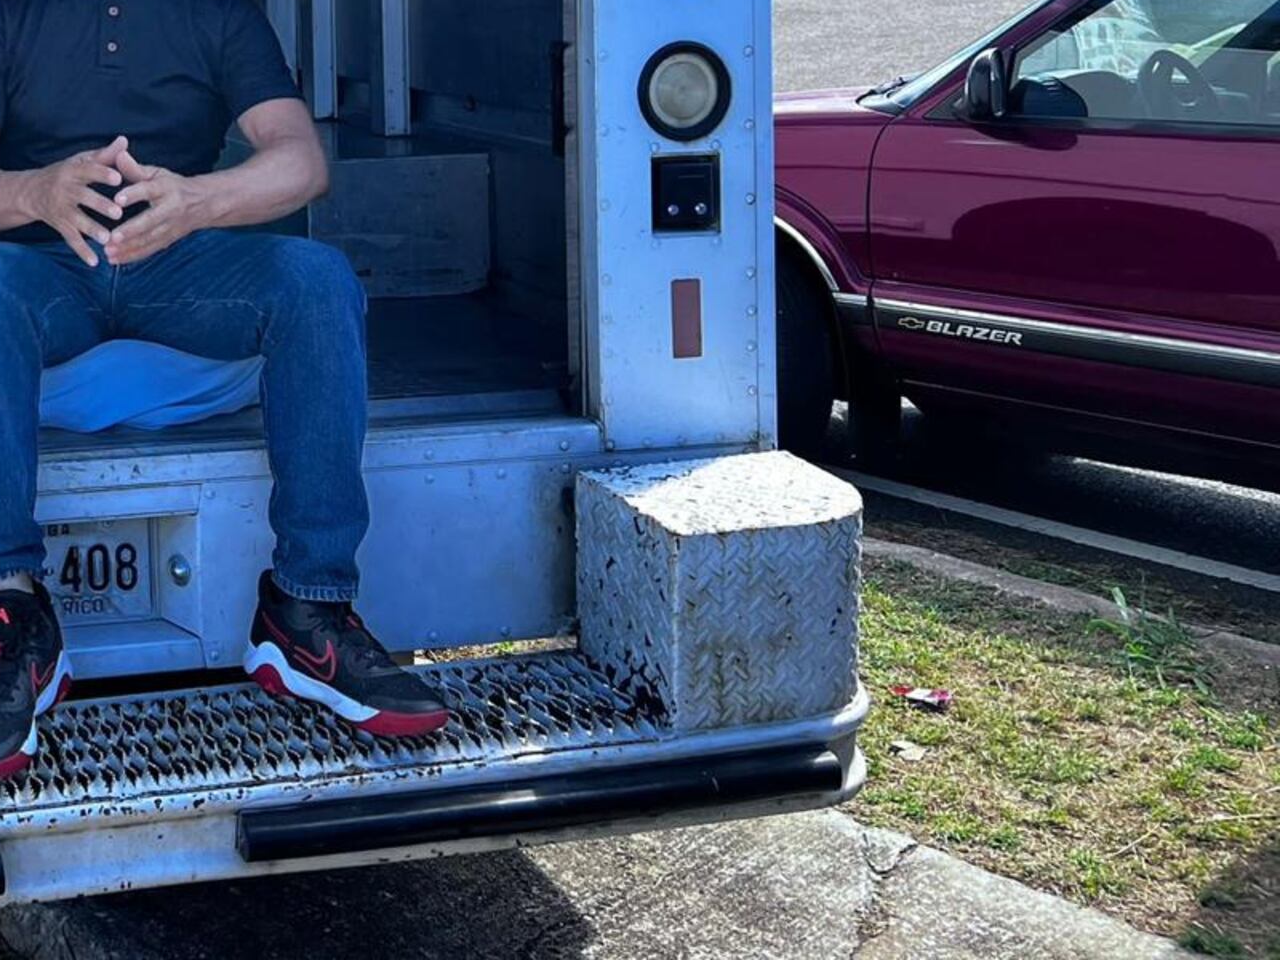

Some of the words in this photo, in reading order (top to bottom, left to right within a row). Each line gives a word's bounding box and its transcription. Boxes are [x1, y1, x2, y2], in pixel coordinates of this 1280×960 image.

[926, 321, 1022, 345] BLAZER
[60, 543, 138, 593] 408
[63, 598, 104, 615] RICO
